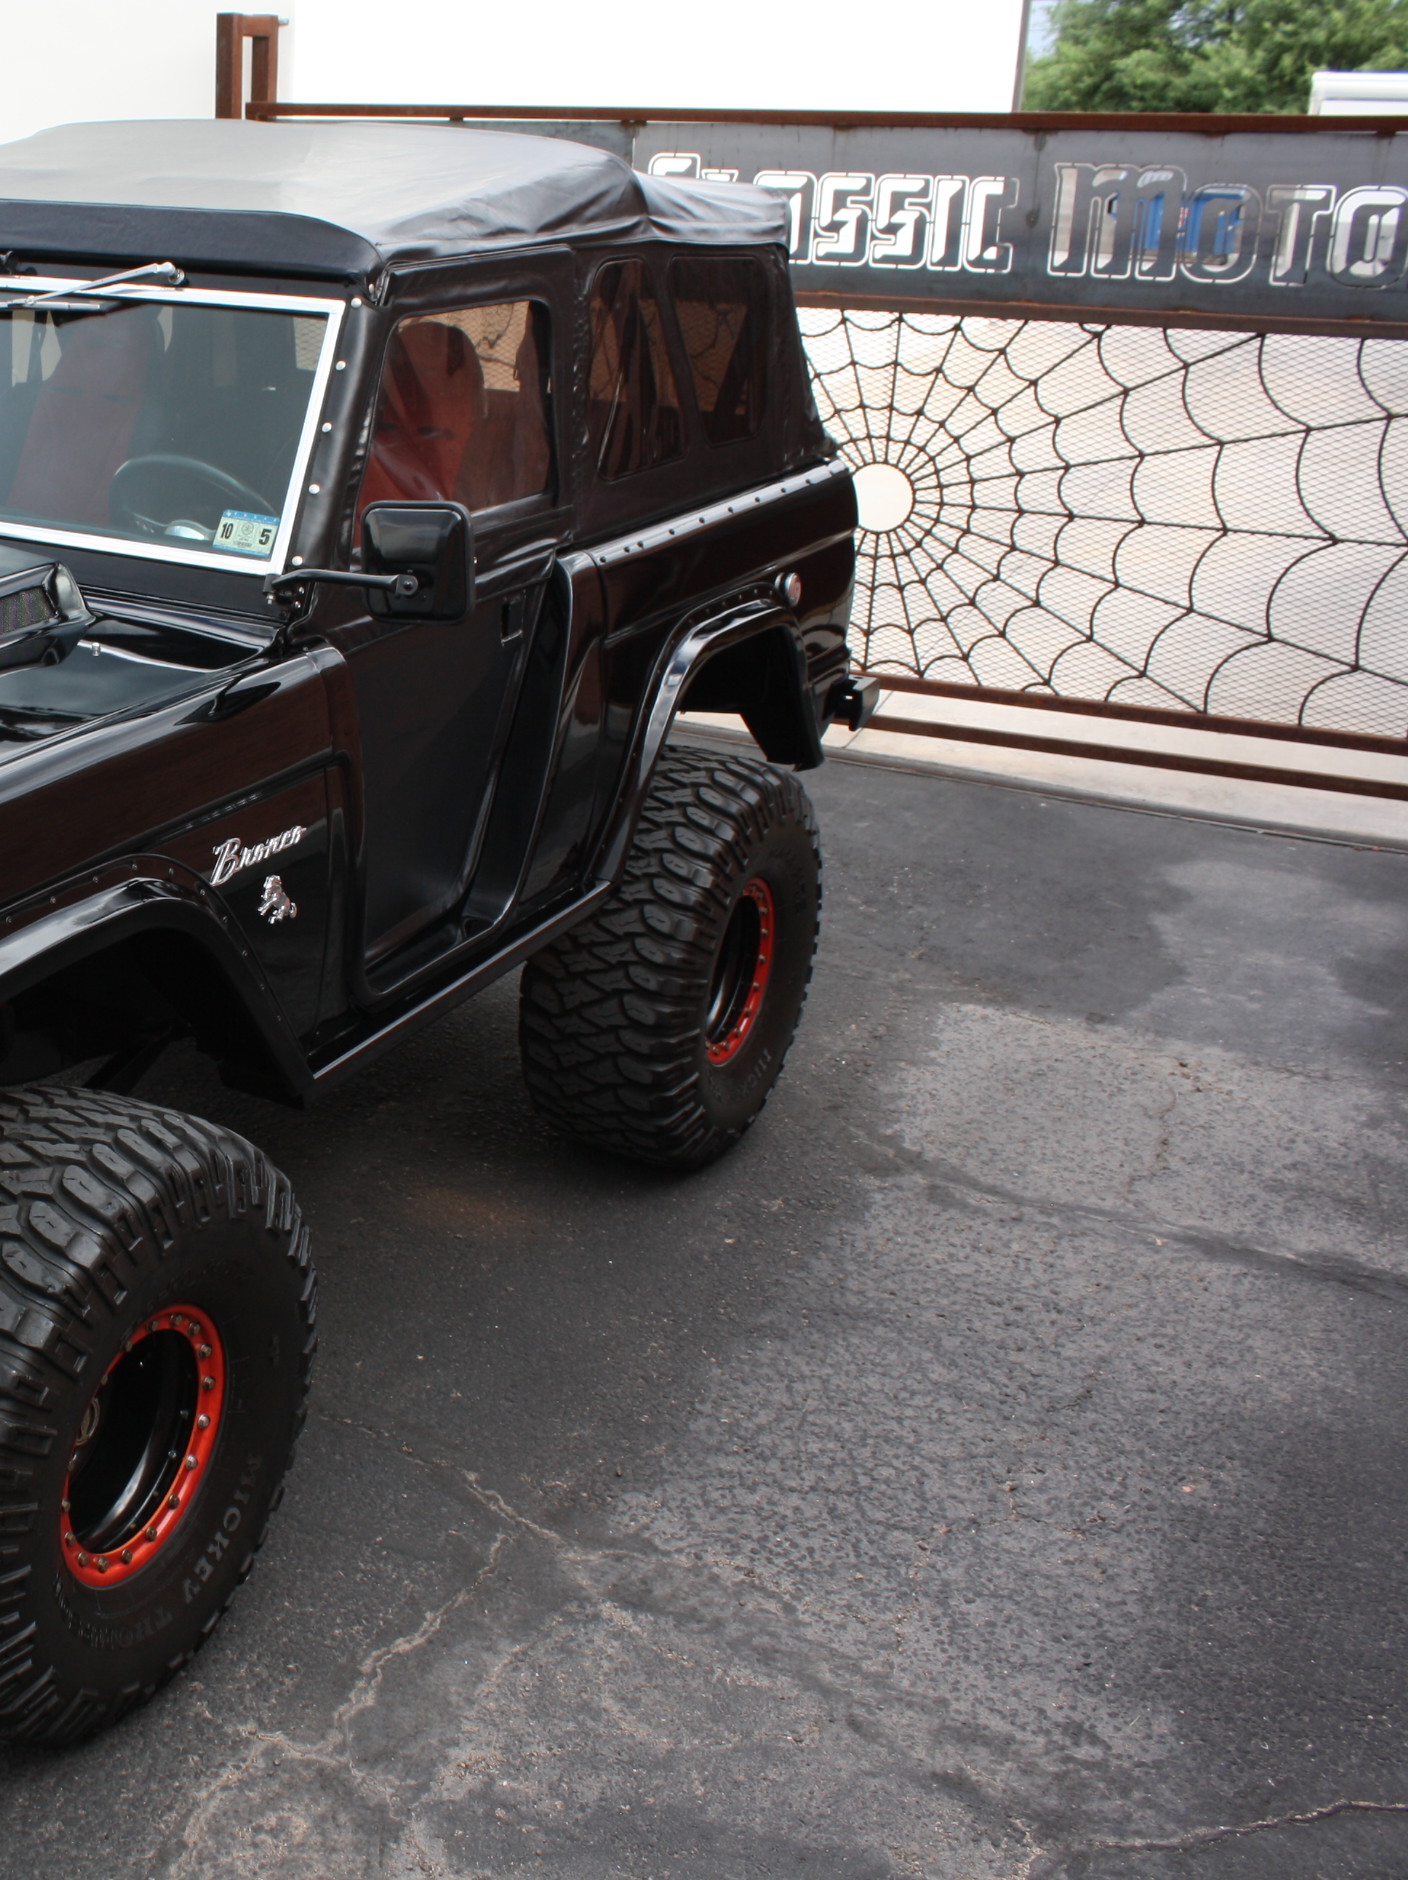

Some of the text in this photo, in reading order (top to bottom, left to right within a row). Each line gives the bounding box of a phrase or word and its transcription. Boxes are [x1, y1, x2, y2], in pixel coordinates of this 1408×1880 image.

[648, 152, 1020, 275] ASSIC
[220, 522, 234, 540] 10
[258, 528, 272, 546] 5
[210, 825, 307, 887] Bronco
